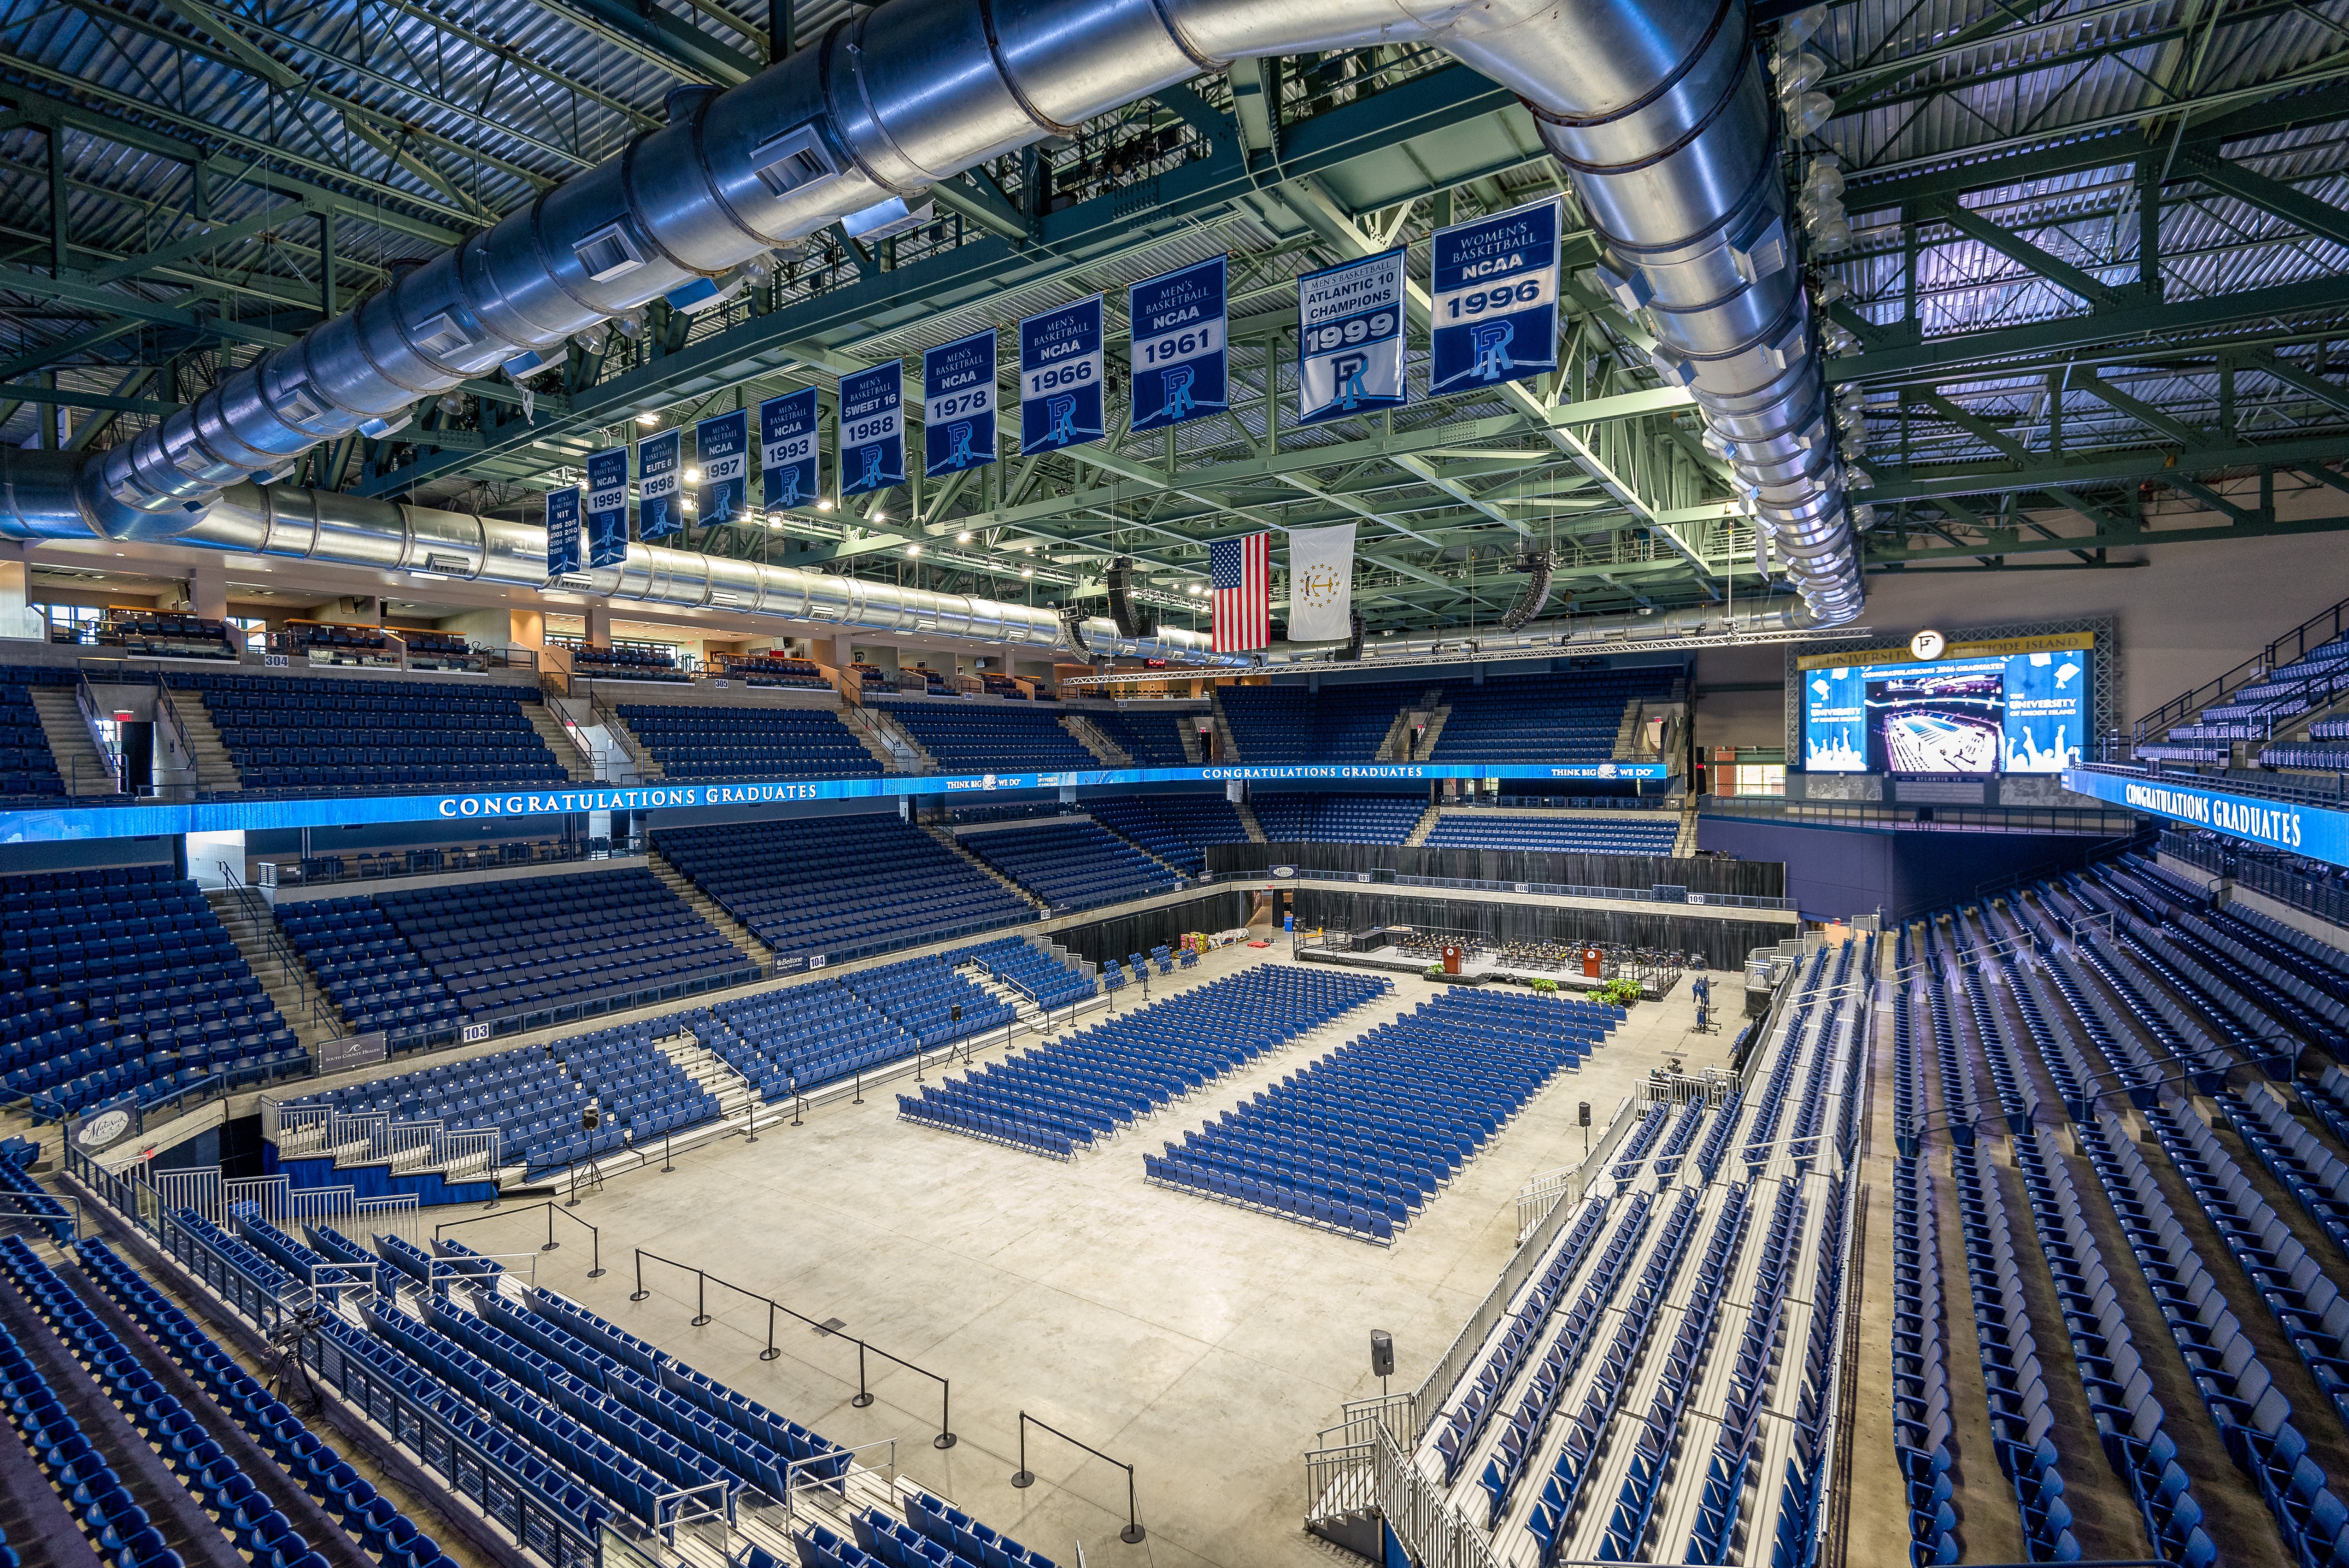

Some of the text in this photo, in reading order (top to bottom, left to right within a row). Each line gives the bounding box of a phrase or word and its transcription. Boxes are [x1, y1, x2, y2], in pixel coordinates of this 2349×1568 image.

[1461, 222, 1528, 249] WOMEN'S
[1453, 236, 1536, 263] BASKETBALL
[1311, 261, 1391, 290] MEN'S BASKETBALL
[1462, 254, 1523, 280] NCAA
[1161, 281, 1193, 299] MEN'S
[1307, 272, 1394, 305] ATLANTIC 10
[1146, 287, 1209, 314] BASKETBALL
[1310, 289, 1391, 319] CHAMPIONS
[1447, 279, 1540, 318] 1996
[1047, 315, 1074, 332] MEN'S
[1154, 306, 1200, 329] NCAA
[1034, 322, 1089, 346] BASKETBALL
[1307, 313, 1394, 352] 1999
[1041, 339, 1080, 360] NCAA
[1145, 328, 1209, 364] 1961
[947, 348, 971, 363] MEN'S
[936, 354, 984, 376] BASKETBALL
[859, 377, 881, 390] MEN'S
[942, 370, 977, 389] NCAA
[1031, 361, 1093, 392] 1966
[850, 383, 891, 402] BASKETBALL
[779, 402, 797, 415] MEN'S
[845, 394, 896, 417] SWEET 16
[933, 390, 987, 419] 1978
[770, 409, 807, 425] BASKETBALL
[705, 430, 738, 444] BASKETBALL
[712, 423, 729, 435] MEN'S
[775, 421, 802, 437] NCAA
[848, 416, 894, 442] 1988
[645, 448, 672, 462] BASKETBALL
[652, 442, 666, 453] MEN'S
[709, 442, 733, 455] NCAA
[769, 439, 809, 463] 1993
[594, 465, 621, 476] BASKETBALL
[646, 458, 672, 473] ELITE 8
[704, 458, 740, 479] 1997
[597, 475, 617, 486] NCAA
[644, 475, 674, 495] 1998
[593, 491, 622, 508] 1999
[557, 510, 569, 519] NIT
[565, 527, 577, 535] 2010
[265, 655, 288, 666] 304
[1826, 650, 1911, 666] UNIVERSITY
[2026, 637, 2079, 650] ISLAND
[1861, 668, 1935, 678] CONGRATULATIONS
[1956, 662, 2006, 672] GRADUATES
[2009, 699, 2077, 710] UNIVERSITY
[1202, 766, 1423, 779] CONGRATULATIONS GRADUATES
[946, 780, 969, 789] THINK
[439, 784, 817, 817] CONGRATULATIONS GRADUATES
[2126, 783, 2302, 847] CONGRATULATIONS GRADUATES
[781, 957, 803, 965] Beltone
[811, 956, 824, 967] 104
[465, 1026, 488, 1040] 103
